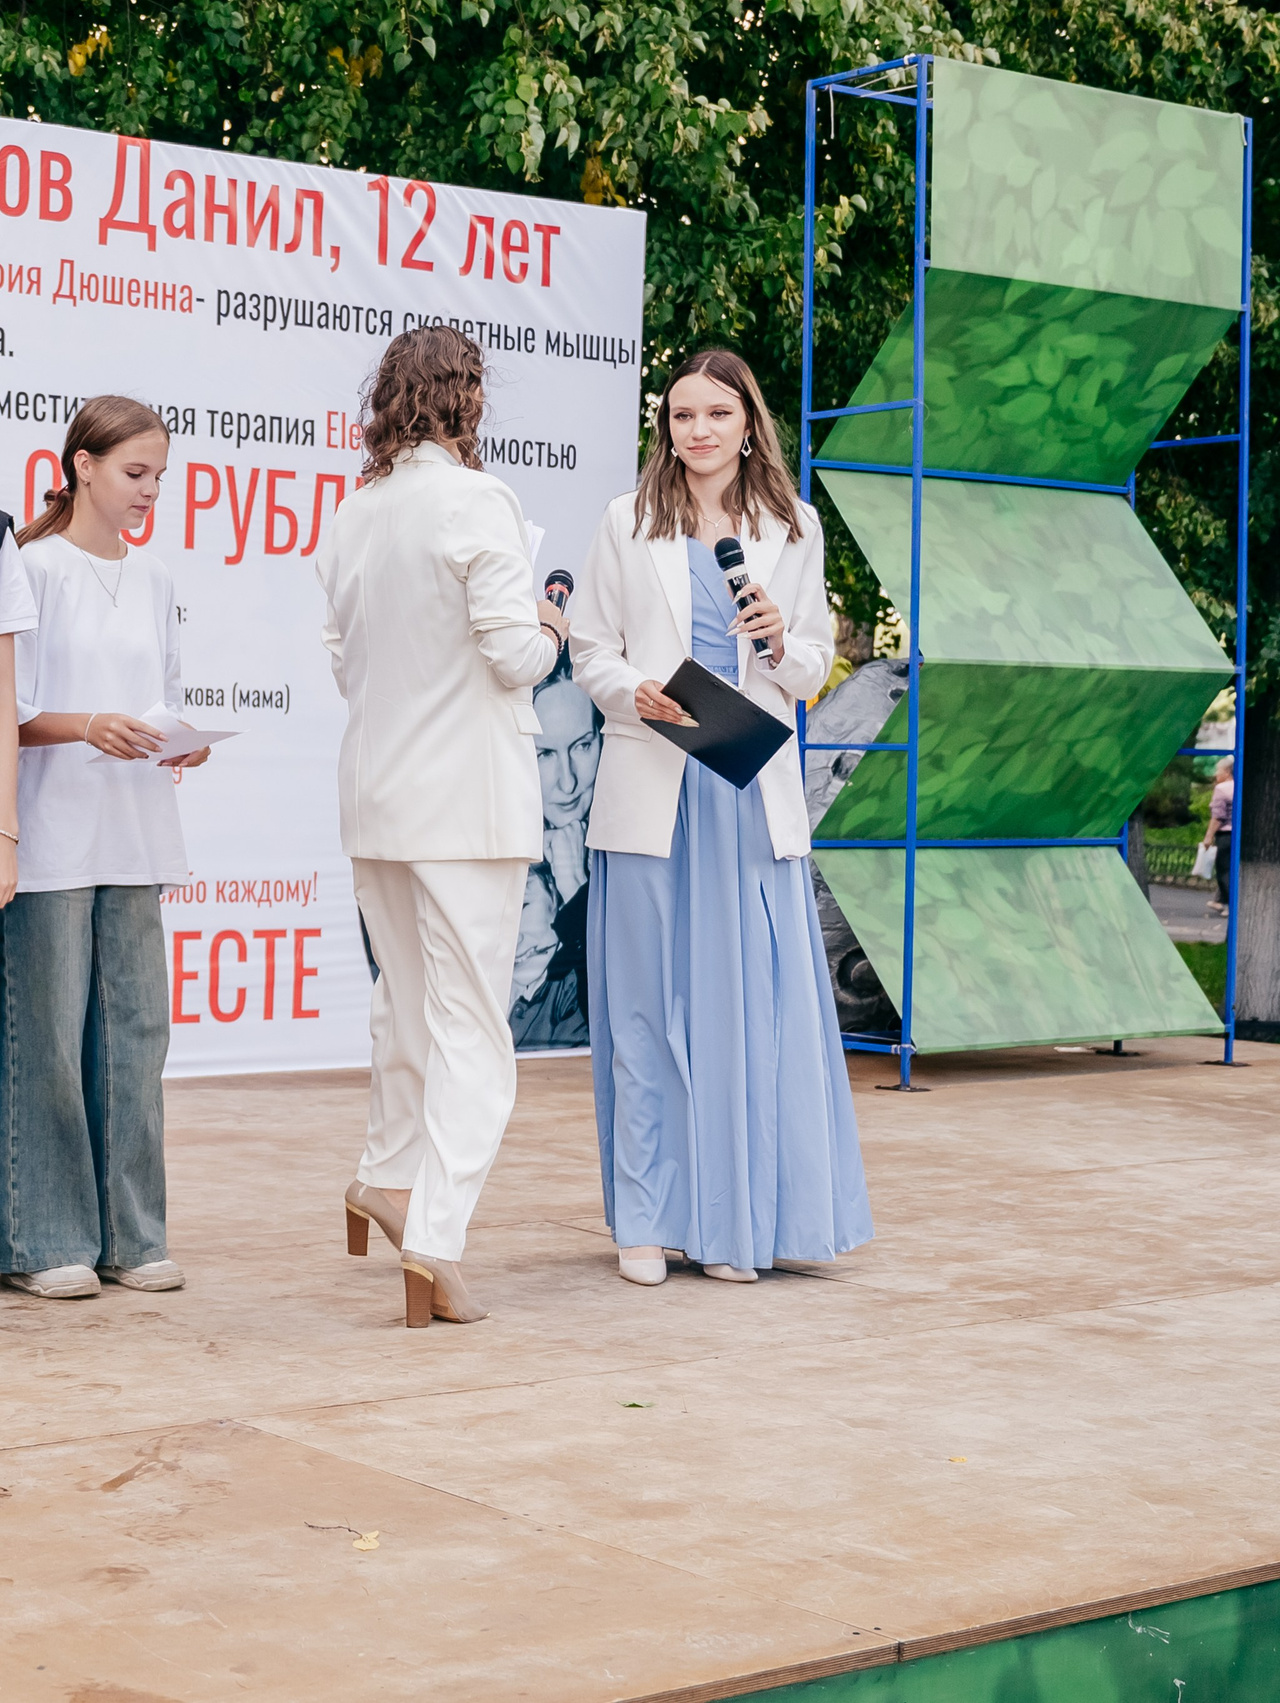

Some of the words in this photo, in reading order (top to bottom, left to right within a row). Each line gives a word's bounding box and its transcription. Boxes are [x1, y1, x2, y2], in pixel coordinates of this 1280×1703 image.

[98, 134, 342, 273] Данил,
[366, 175, 437, 273] 12
[458, 214, 562, 287] лет
[52, 258, 205, 314] Дюшенна-
[215, 286, 393, 336] разрушаются
[544, 331, 637, 368] мышцы
[207, 407, 316, 450] терапия
[476, 436, 578, 471] имостью
[183, 461, 362, 566] РУБЛ
[181, 686, 225, 707] кова
[232, 682, 291, 715] (мама)
[215, 870, 319, 909] каждому!
[171, 927, 322, 1025] ЕСТЕ
